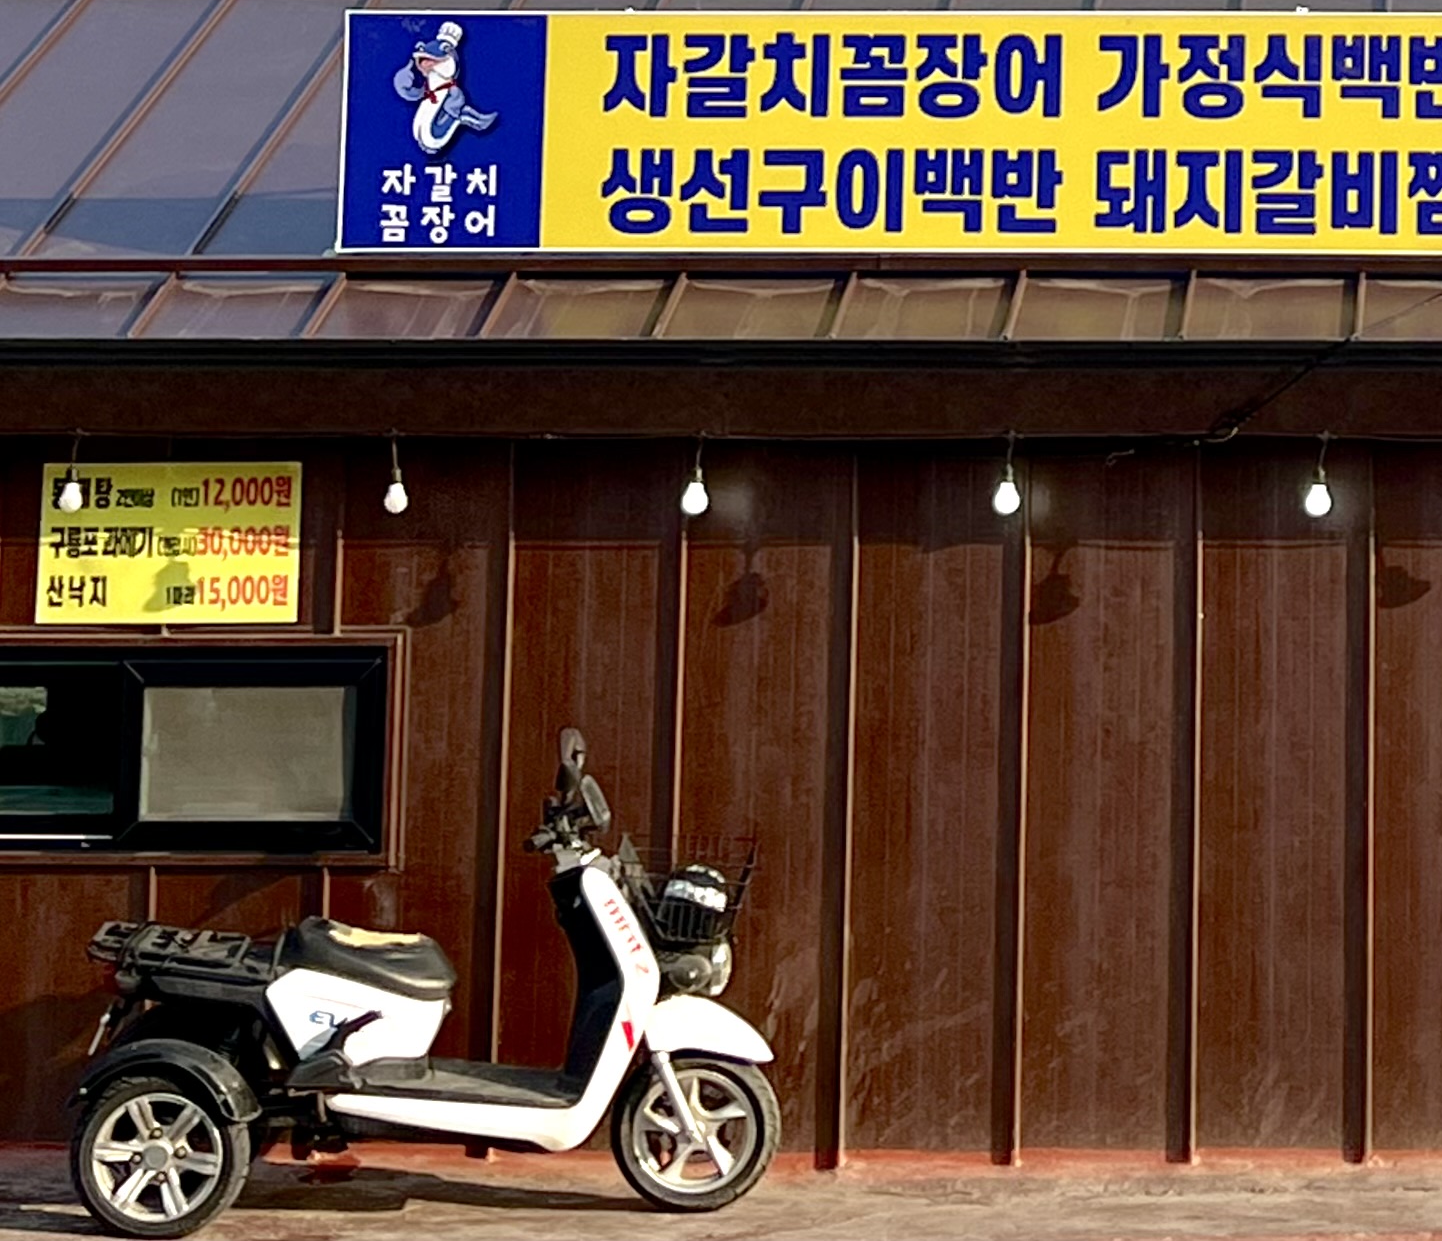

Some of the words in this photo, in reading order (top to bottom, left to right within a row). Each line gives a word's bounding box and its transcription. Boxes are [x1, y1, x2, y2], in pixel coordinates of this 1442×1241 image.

[603, 32, 1063, 119] 자갈치꼼장어
[380, 163, 498, 203] 자갈치
[601, 148, 1064, 235] 생선구이백반
[379, 204, 496, 244] 꼼장어
[202, 476, 292, 514] 12,000원
[197, 526, 290, 561] 30,000원
[197, 574, 289, 611] 15,000원
